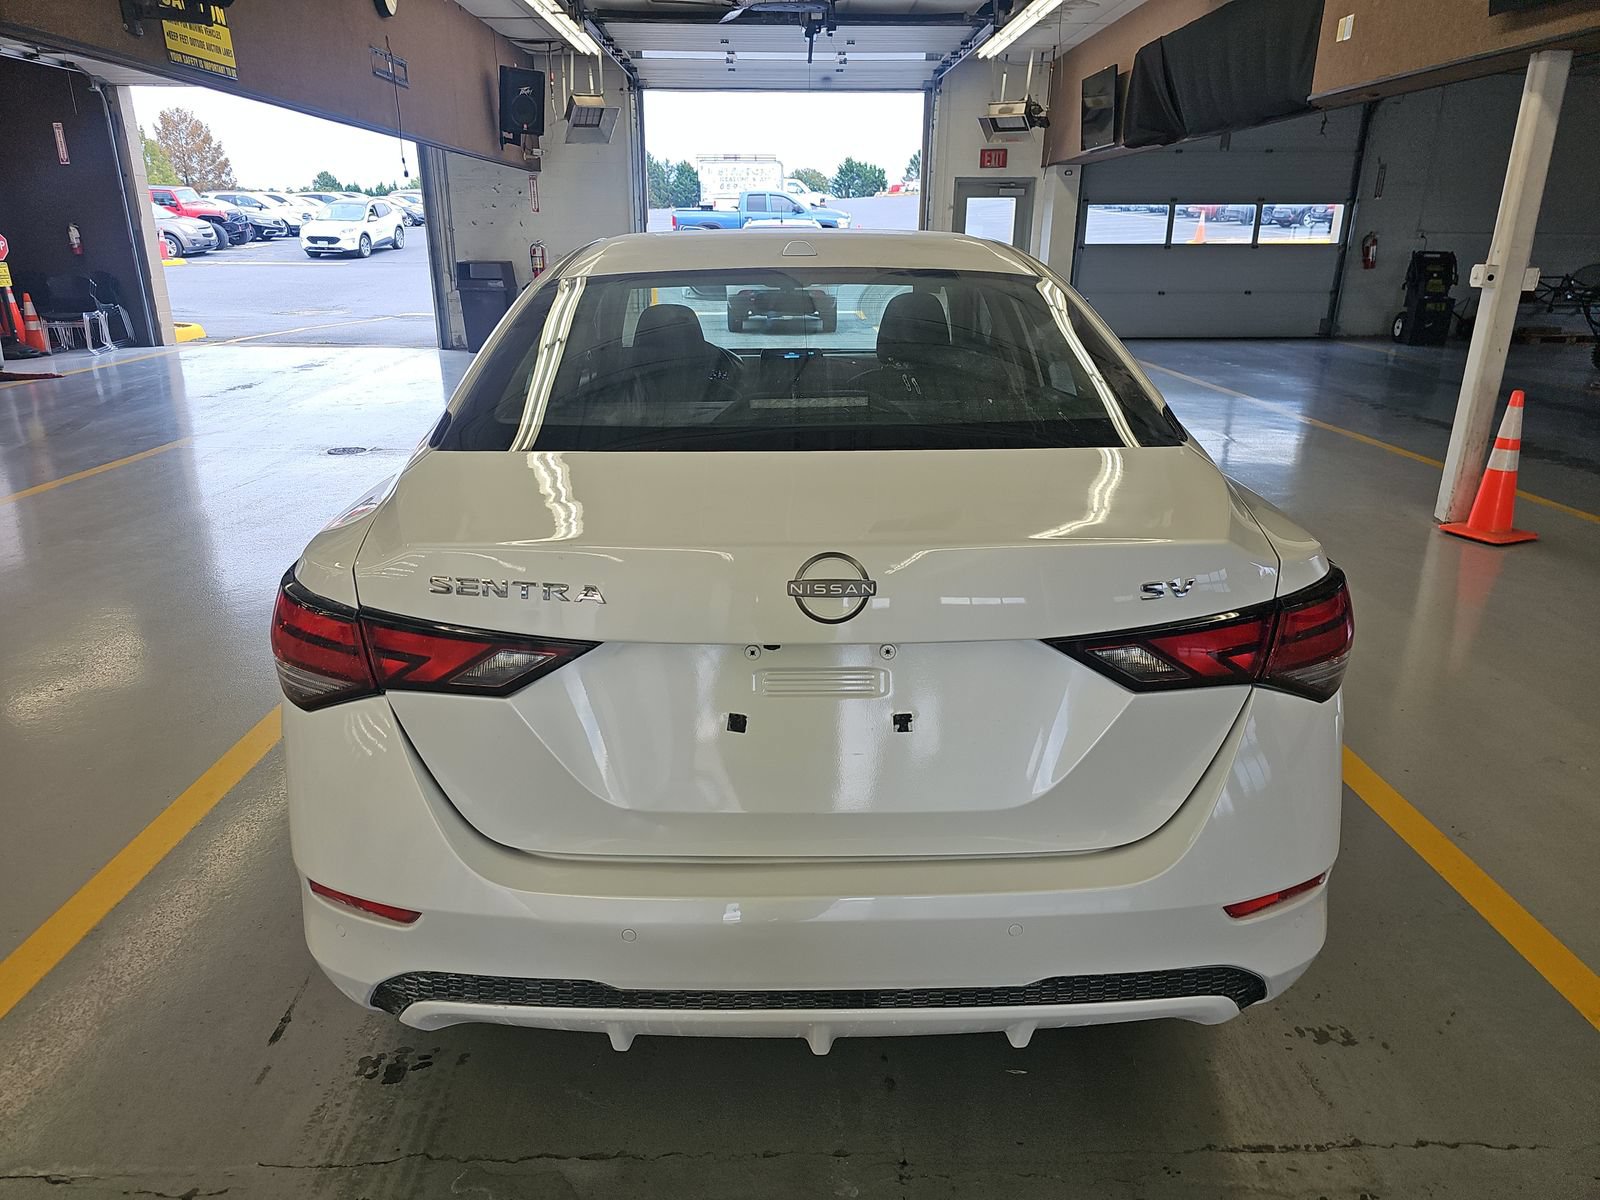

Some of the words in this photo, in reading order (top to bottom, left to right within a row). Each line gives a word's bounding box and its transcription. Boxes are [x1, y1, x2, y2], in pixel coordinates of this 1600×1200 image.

[179, 34, 189, 45] FEET
[190, 37, 206, 50] OUTSIDE
[206, 42, 222, 55] AUCTION
[182, 55, 198, 67] SAFETY
[984, 151, 1003, 167] EXIT
[429, 575, 607, 605] SENTRA
[790, 583, 874, 594] NISSAN
[1140, 577, 1196, 600] SV
